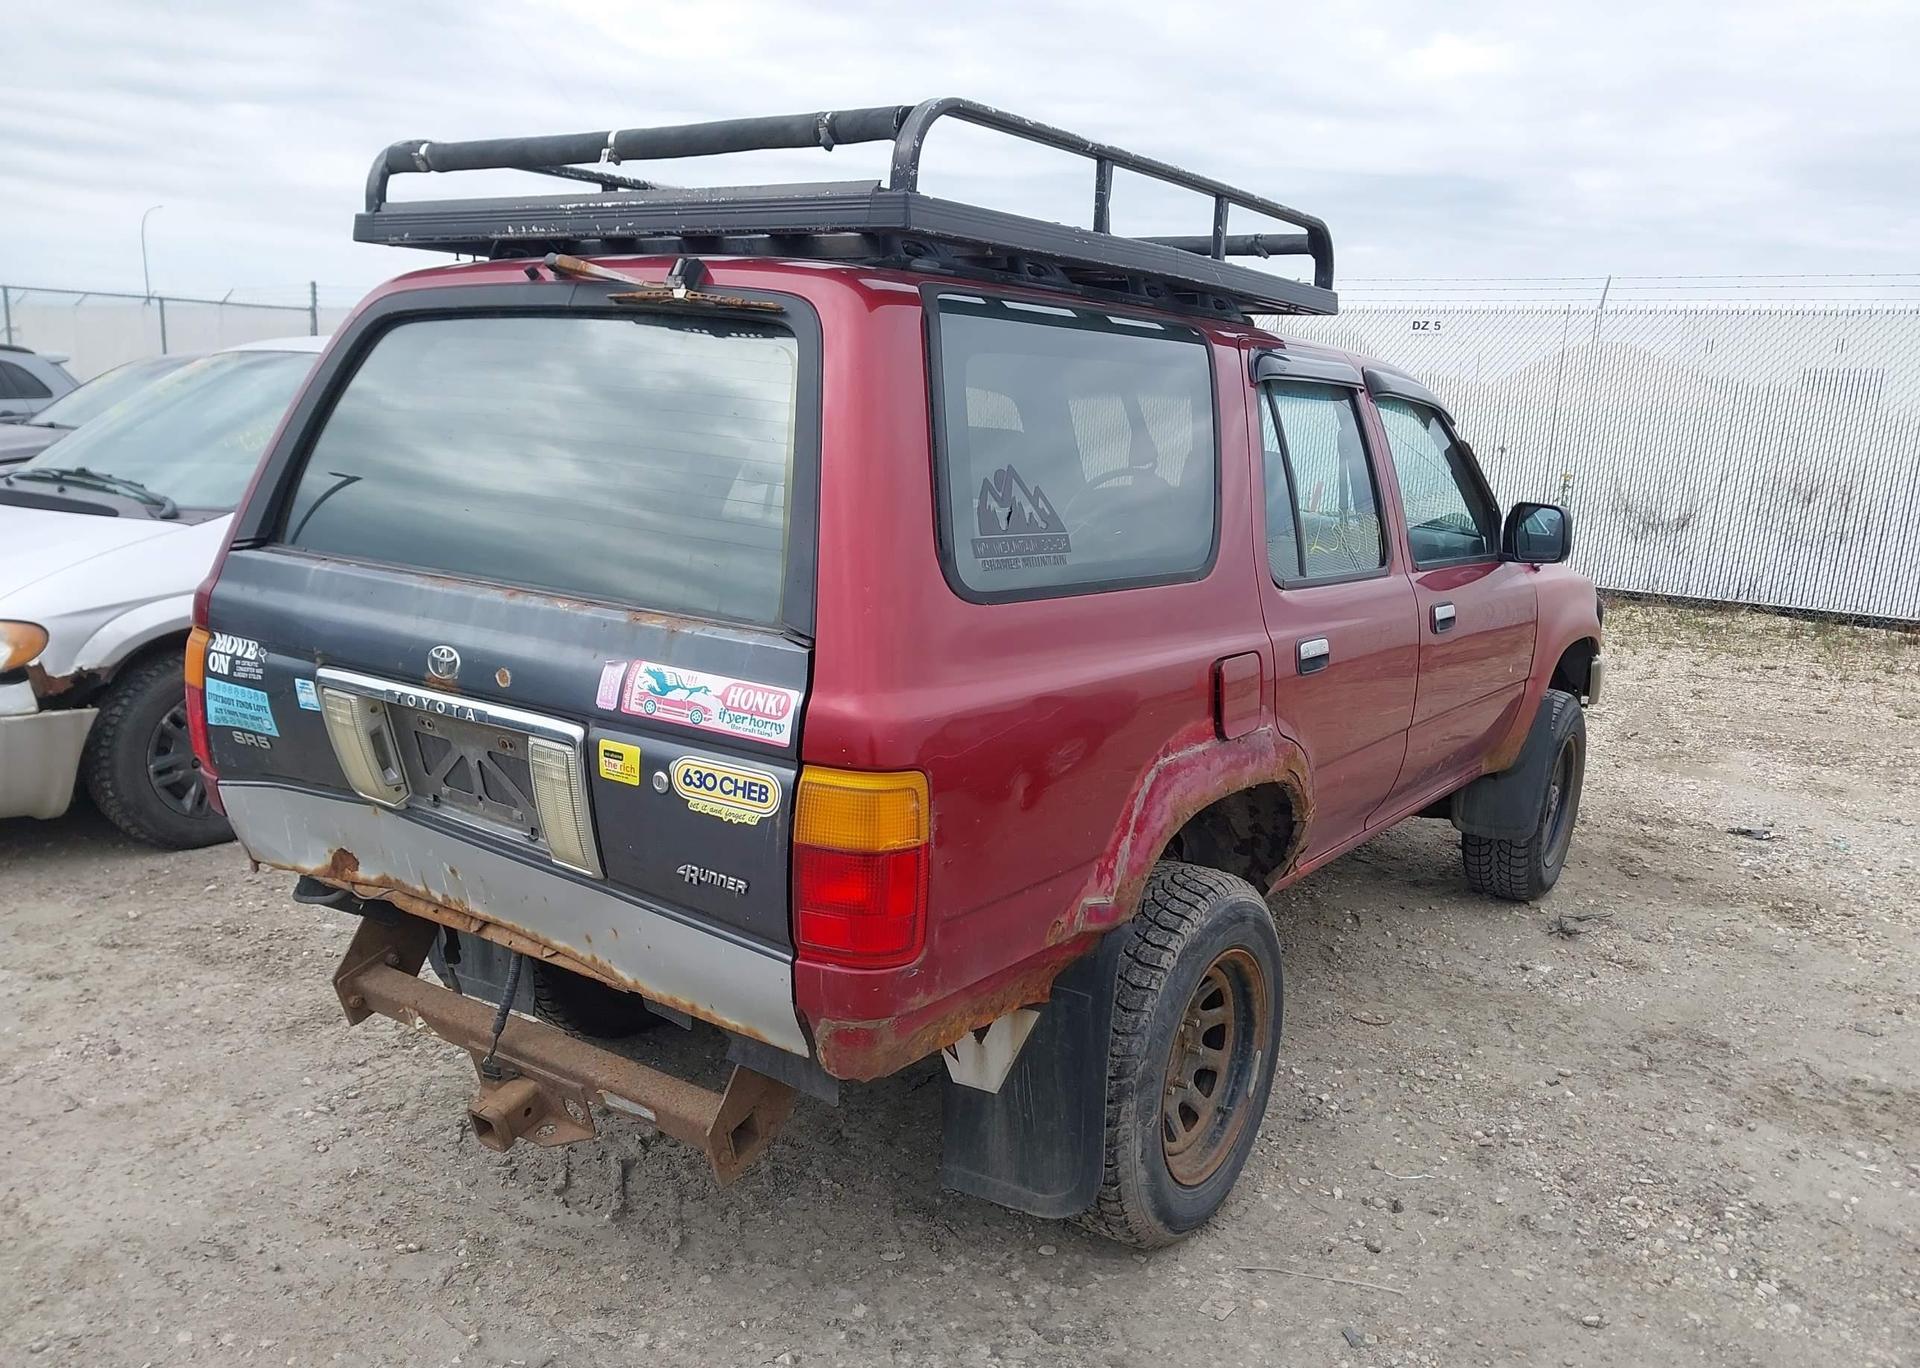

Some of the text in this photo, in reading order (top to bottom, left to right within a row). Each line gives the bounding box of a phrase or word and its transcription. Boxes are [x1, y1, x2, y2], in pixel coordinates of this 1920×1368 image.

[1412, 320, 1441, 331] DZ 5
[210, 631, 259, 660] MOVE
[208, 652, 231, 676] ON
[394, 691, 476, 721] TOYOTA
[725, 685, 787, 717] HONK!
[718, 707, 785, 735] if yer horny
[232, 730, 271, 749] SR5
[604, 759, 618, 770] the
[619, 762, 636, 774] rich
[682, 768, 769, 803] 630 CHEB
[689, 801, 759, 824] set it and forget it!
